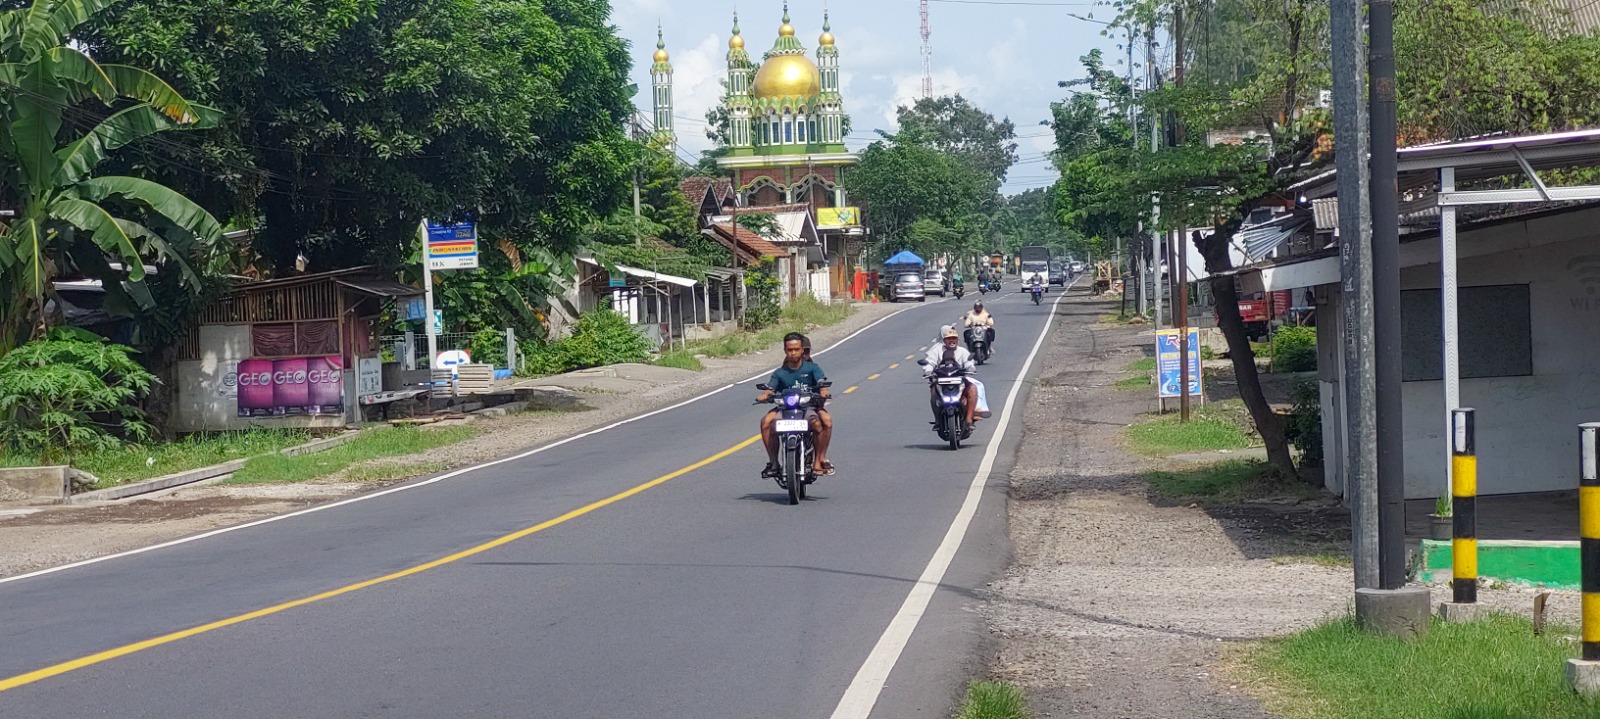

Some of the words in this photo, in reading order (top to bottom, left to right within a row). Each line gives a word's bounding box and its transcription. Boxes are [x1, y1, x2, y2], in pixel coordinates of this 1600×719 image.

[238, 372, 272, 386] GEO
[273, 370, 307, 384] GEO
[308, 369, 341, 383] GEO
